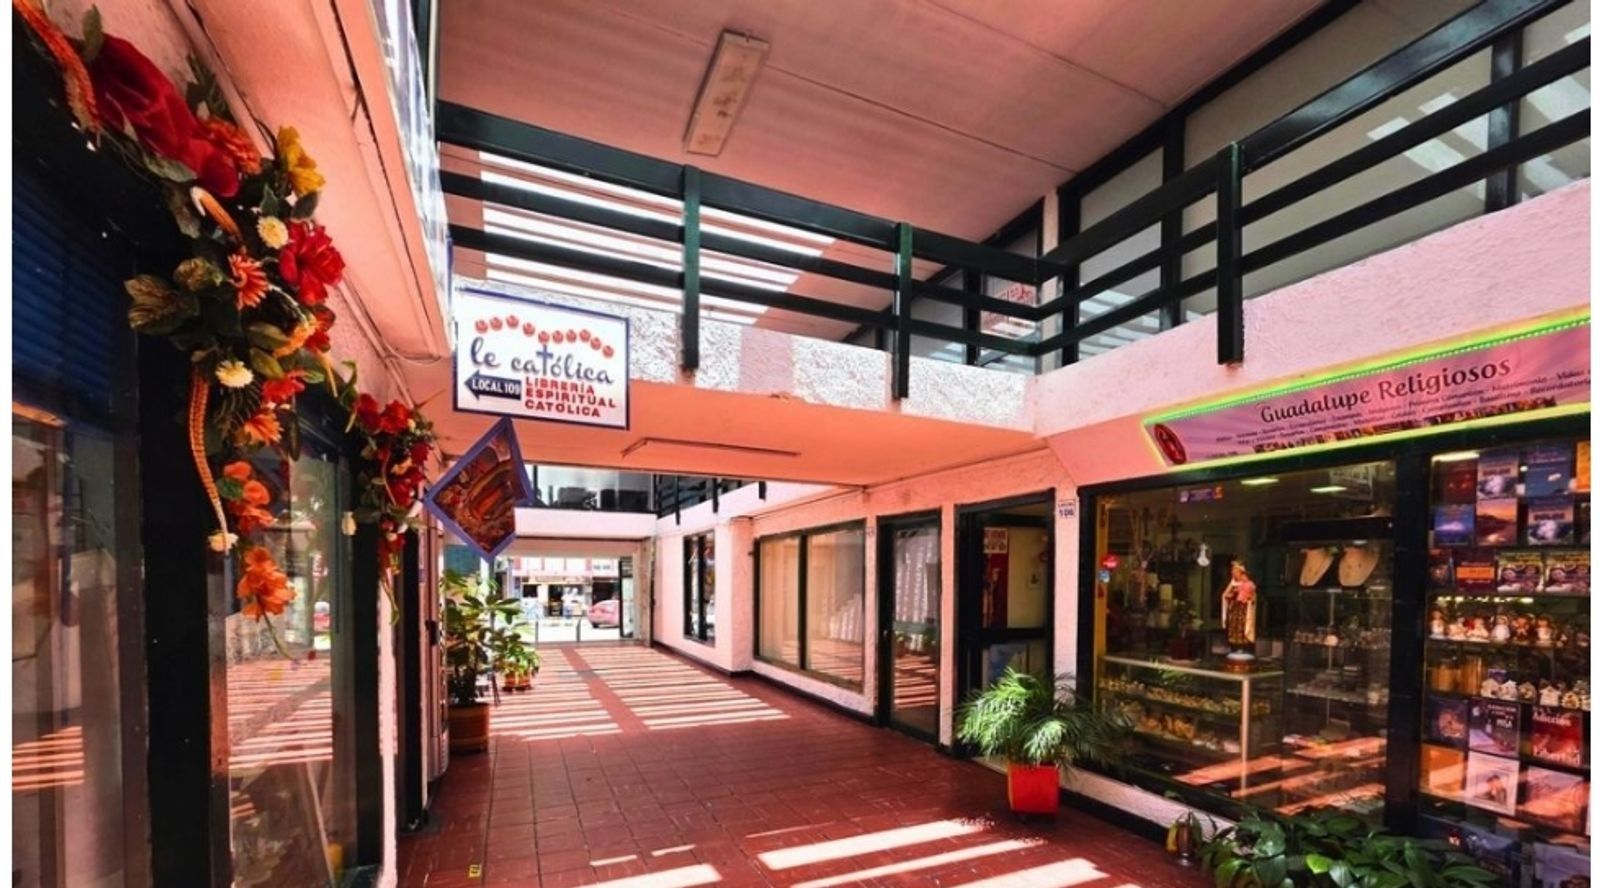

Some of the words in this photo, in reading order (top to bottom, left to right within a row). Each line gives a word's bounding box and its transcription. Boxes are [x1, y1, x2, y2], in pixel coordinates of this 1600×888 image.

[470, 337, 501, 368] le
[511, 344, 615, 384] católica
[472, 379, 502, 393] LOCAL
[504, 382, 521, 396] 109
[525, 376, 595, 395] LIBRERÍA
[1261, 390, 1373, 423] Guadalupe
[1378, 359, 1512, 401] Religiosos
[525, 387, 616, 409] ESPIRITUAL
